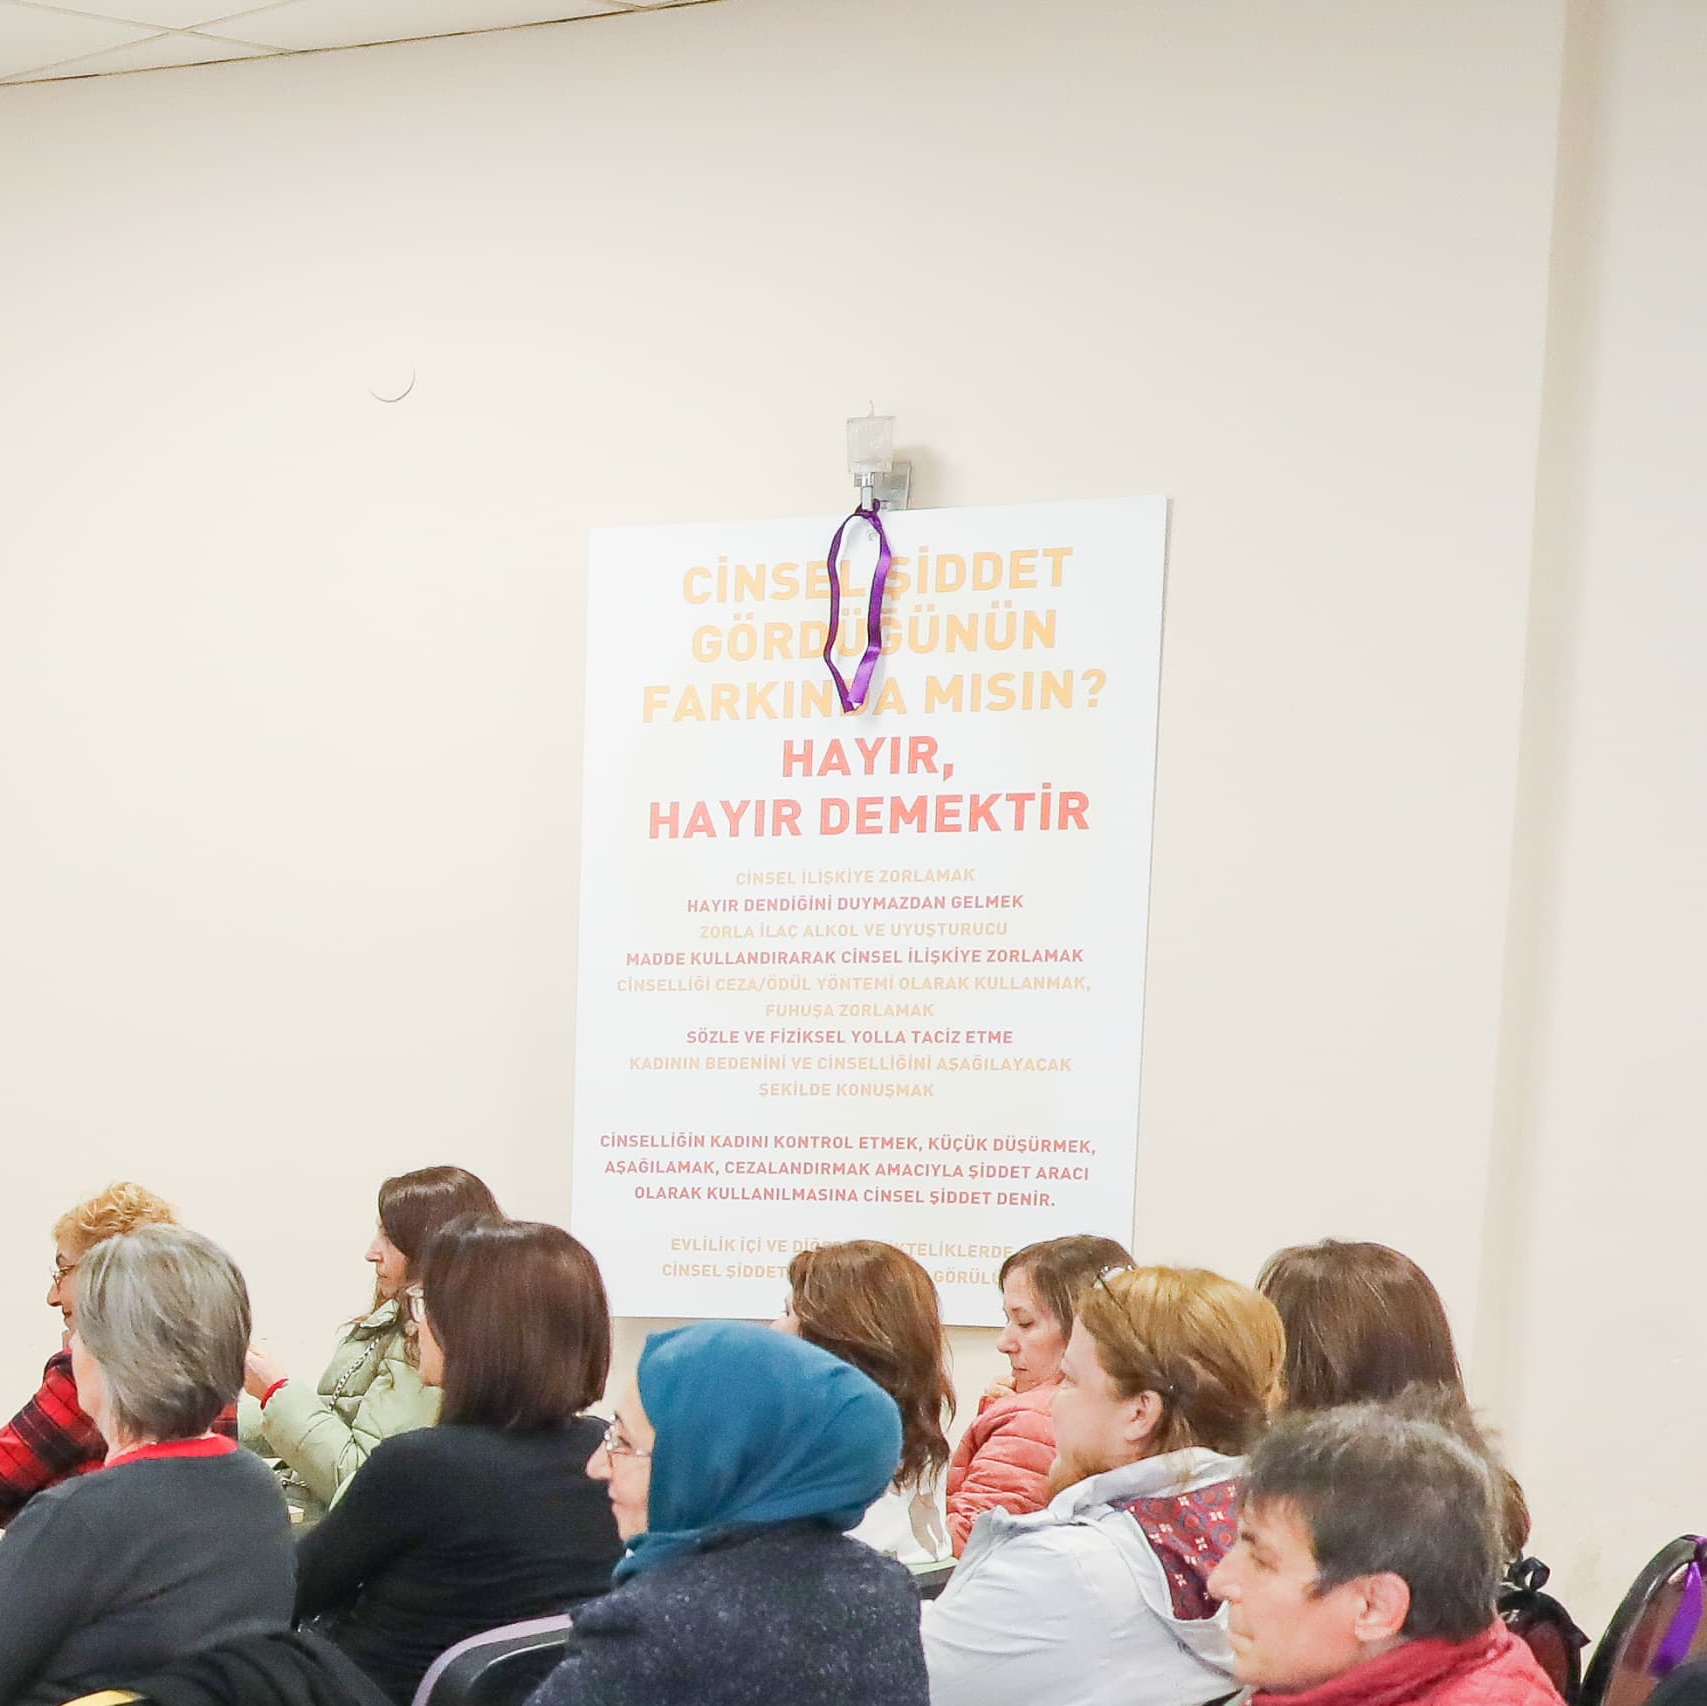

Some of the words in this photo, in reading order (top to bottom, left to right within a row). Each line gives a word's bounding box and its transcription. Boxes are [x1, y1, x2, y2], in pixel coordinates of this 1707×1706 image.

[643, 680, 908, 723] FARKINA
[925, 669, 1106, 713] MISIN?
[783, 736, 953, 781] HAYIR,
[650, 799, 801, 839] HAYIR
[820, 782, 1089, 835] DEMEKTİR
[735, 868, 796, 886] CİNSEL
[802, 868, 874, 885] İLİŞKİYE
[879, 868, 975, 883] ZORLAMAK
[688, 899, 738, 912] HAYIR
[745, 895, 831, 912] DENDİĞİNİ
[838, 896, 945, 910] DUYMAZDAN
[951, 895, 1023, 908] GELMEK
[627, 953, 685, 965] MADDE
[691, 951, 835, 965] KULLANDIRARAK
[842, 948, 903, 963] CİNSEL
[908, 947, 982, 965] İLİŞKİYE
[987, 949, 1083, 962] ZORLAMAK
[687, 1028, 739, 1043] SÖZLE
[745, 1031, 765, 1043] VE
[771, 1028, 845, 1043] FİZİKSEL
[851, 1031, 906, 1043] YOLLA
[911, 1028, 961, 1043] TACİZ
[966, 1031, 1013, 1044] ETME
[601, 1132, 704, 1147] CİNSELLİĞİN
[711, 1136, 768, 1148] KADINI
[774, 1136, 853, 1149] KONTROL
[859, 1137, 922, 1152] ETMEK,
[929, 1134, 987, 1152] KÜÇÜK
[993, 1135, 1095, 1155] DÜŞÜRMEK,
[605, 1158, 719, 1176] AŞAĞILAMAK,
[725, 1161, 869, 1175] CEZALANDIRMAK
[875, 1163, 963, 1177] AMACIYLA
[968, 1162, 1031, 1179] ŞİDDET
[1035, 1167, 1088, 1180] ARACI
[635, 1187, 701, 1199] OLARAK
[707, 1187, 858, 1202] KULLANILMASINA
[864, 1187, 924, 1203] CİNSEL
[930, 1188, 992, 1205] ŞİDDET
[997, 1190, 1055, 1206] DENİR.
